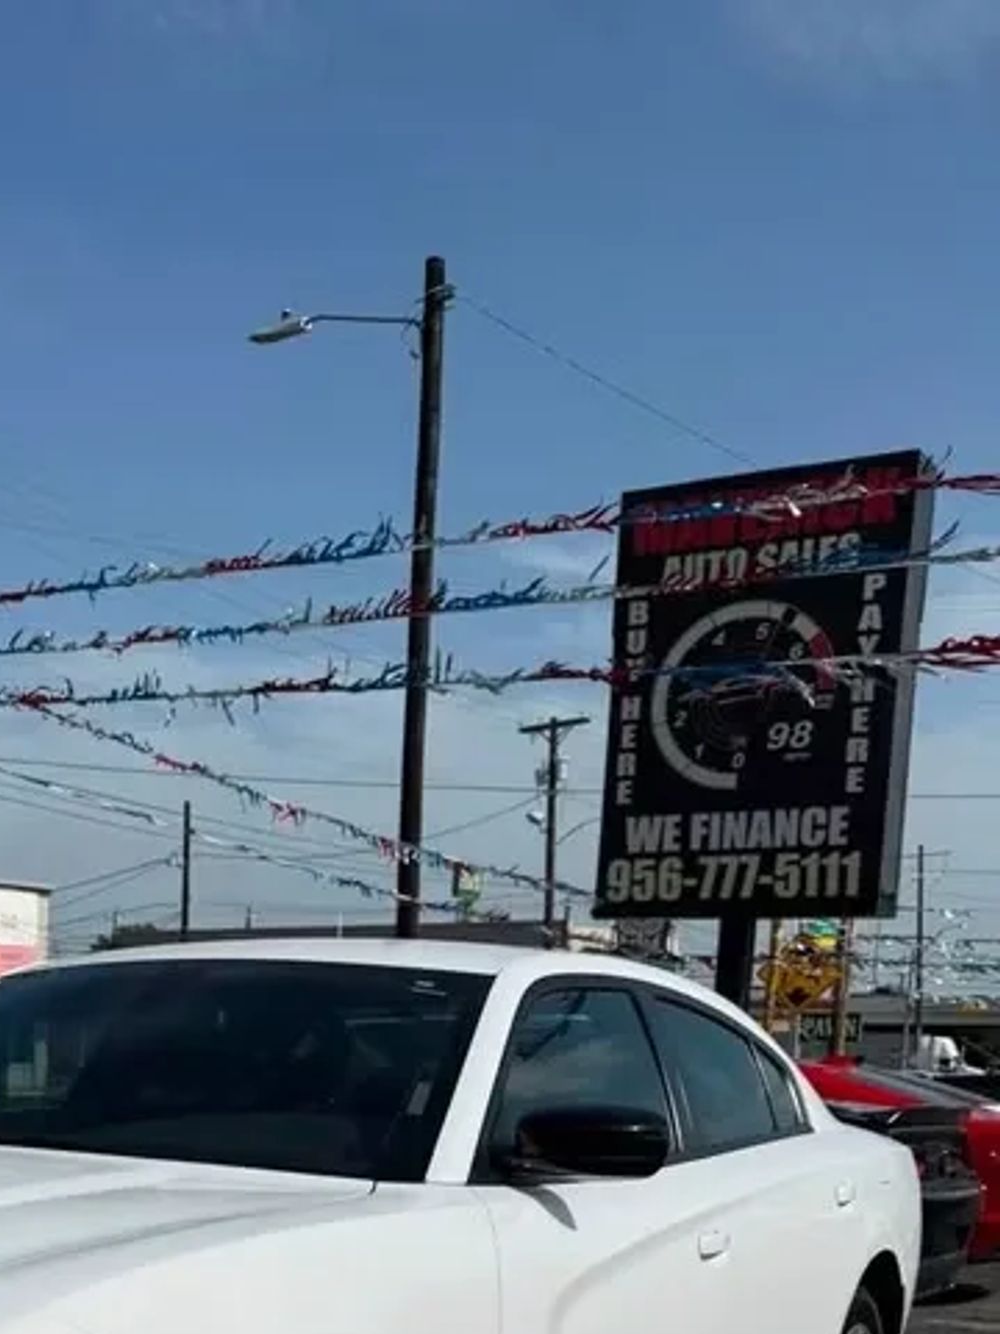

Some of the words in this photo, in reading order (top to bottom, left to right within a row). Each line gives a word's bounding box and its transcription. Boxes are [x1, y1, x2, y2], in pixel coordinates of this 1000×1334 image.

[661, 547, 749, 585] AUTO
[857, 573, 887, 659] PAY
[616, 696, 643, 805] HERE
[766, 719, 813, 751] 98
[844, 676, 876, 793] HERE
[626, 814, 682, 853] WE
[690, 805, 849, 850] FINANCE
[607, 850, 861, 901] 956-777-5111
